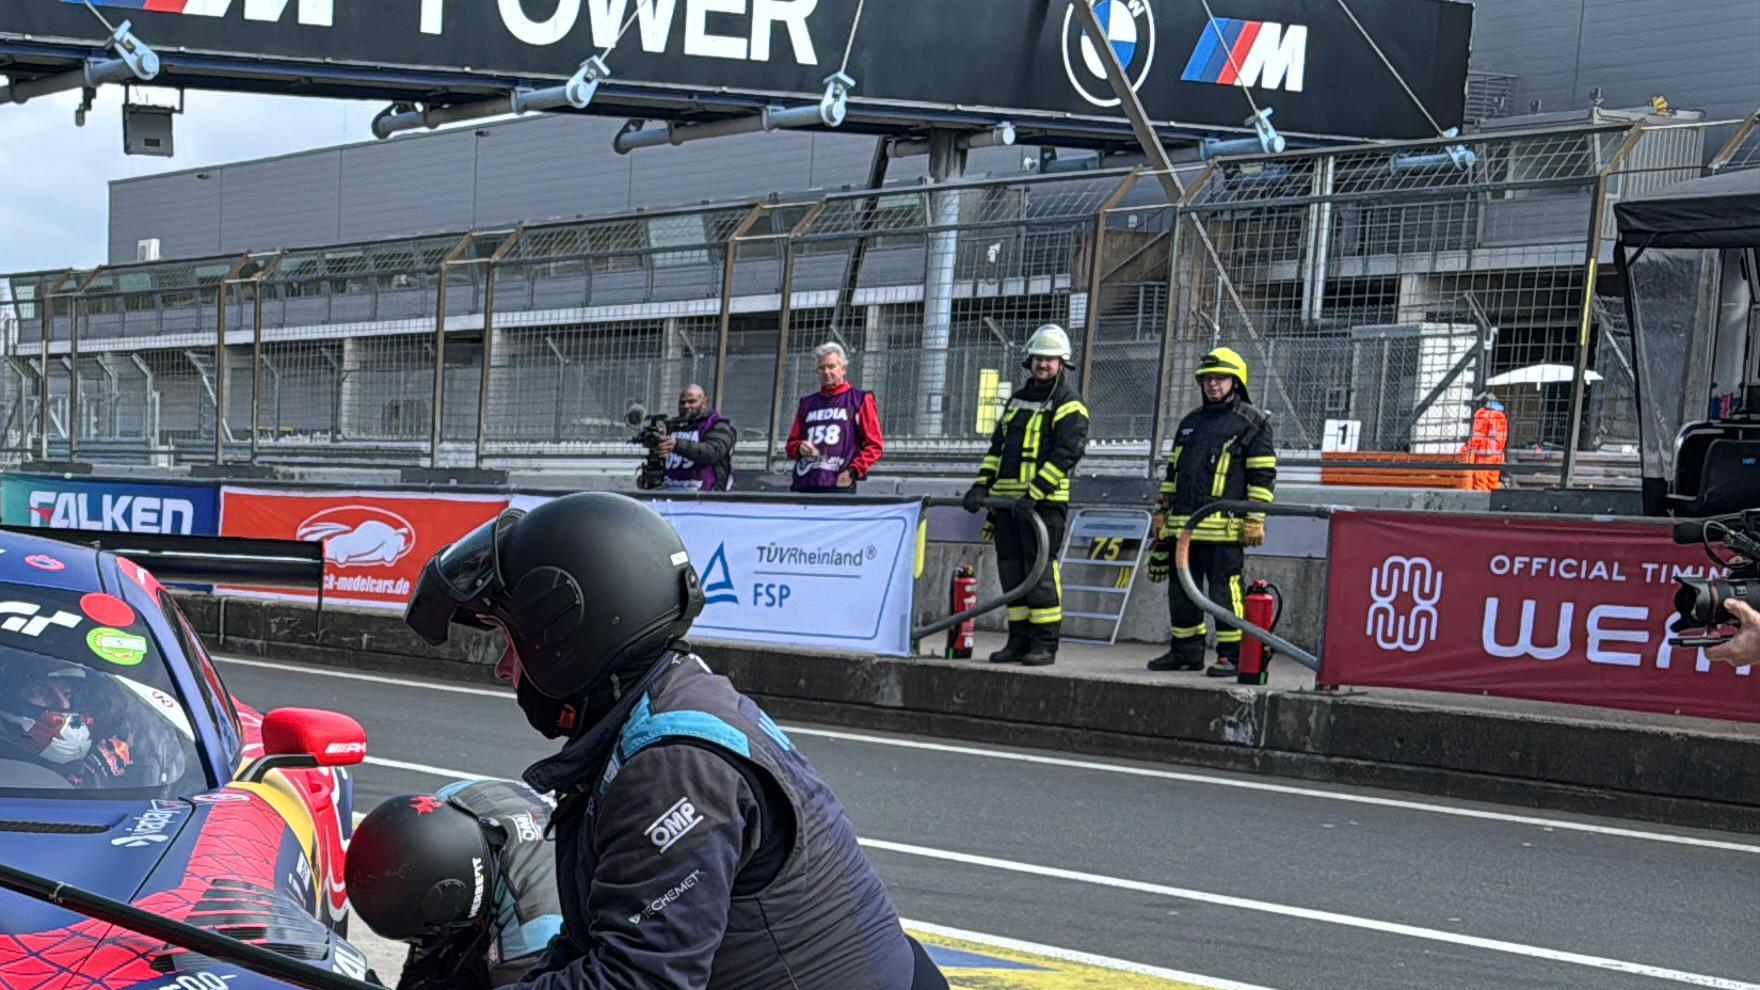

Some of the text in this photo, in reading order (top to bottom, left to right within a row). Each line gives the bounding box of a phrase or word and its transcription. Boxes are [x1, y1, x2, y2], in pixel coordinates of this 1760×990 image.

[805, 407, 848, 423] MEDIA
[808, 424, 841, 445] 158
[30, 490, 194, 535] FALKEN
[1091, 537, 1123, 561] 75
[1490, 554, 1730, 585] OFFICIAL TIMIN
[753, 583, 791, 608] FSP
[651, 801, 696, 847] OMP
